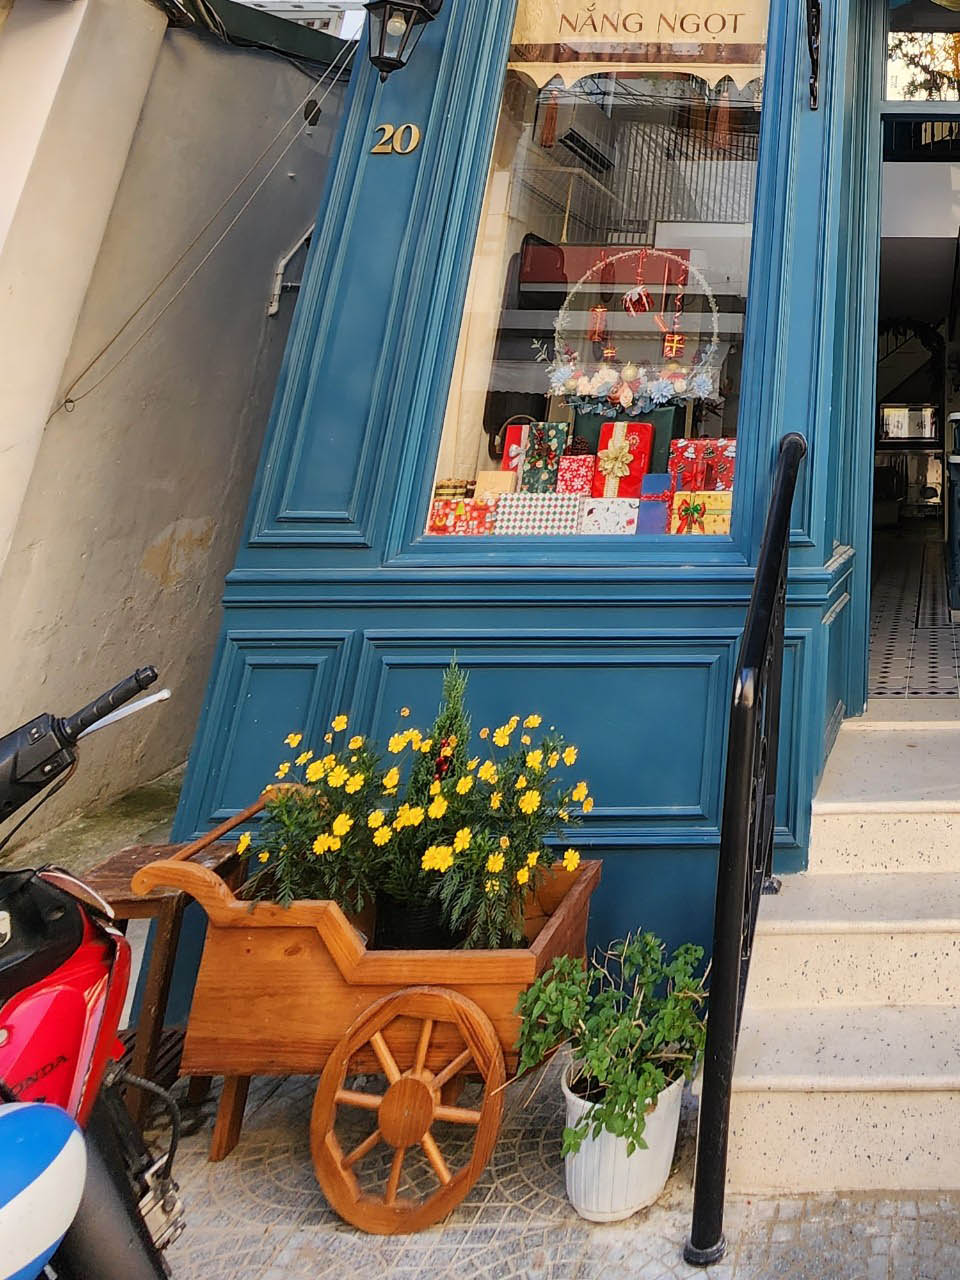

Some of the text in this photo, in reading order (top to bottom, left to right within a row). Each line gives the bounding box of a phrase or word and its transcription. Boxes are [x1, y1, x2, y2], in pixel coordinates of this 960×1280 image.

[558, 2, 745, 40] NẮNG NGỌT
[370, 123, 420, 154] 20
[10, 1053, 68, 1096] ONDA
